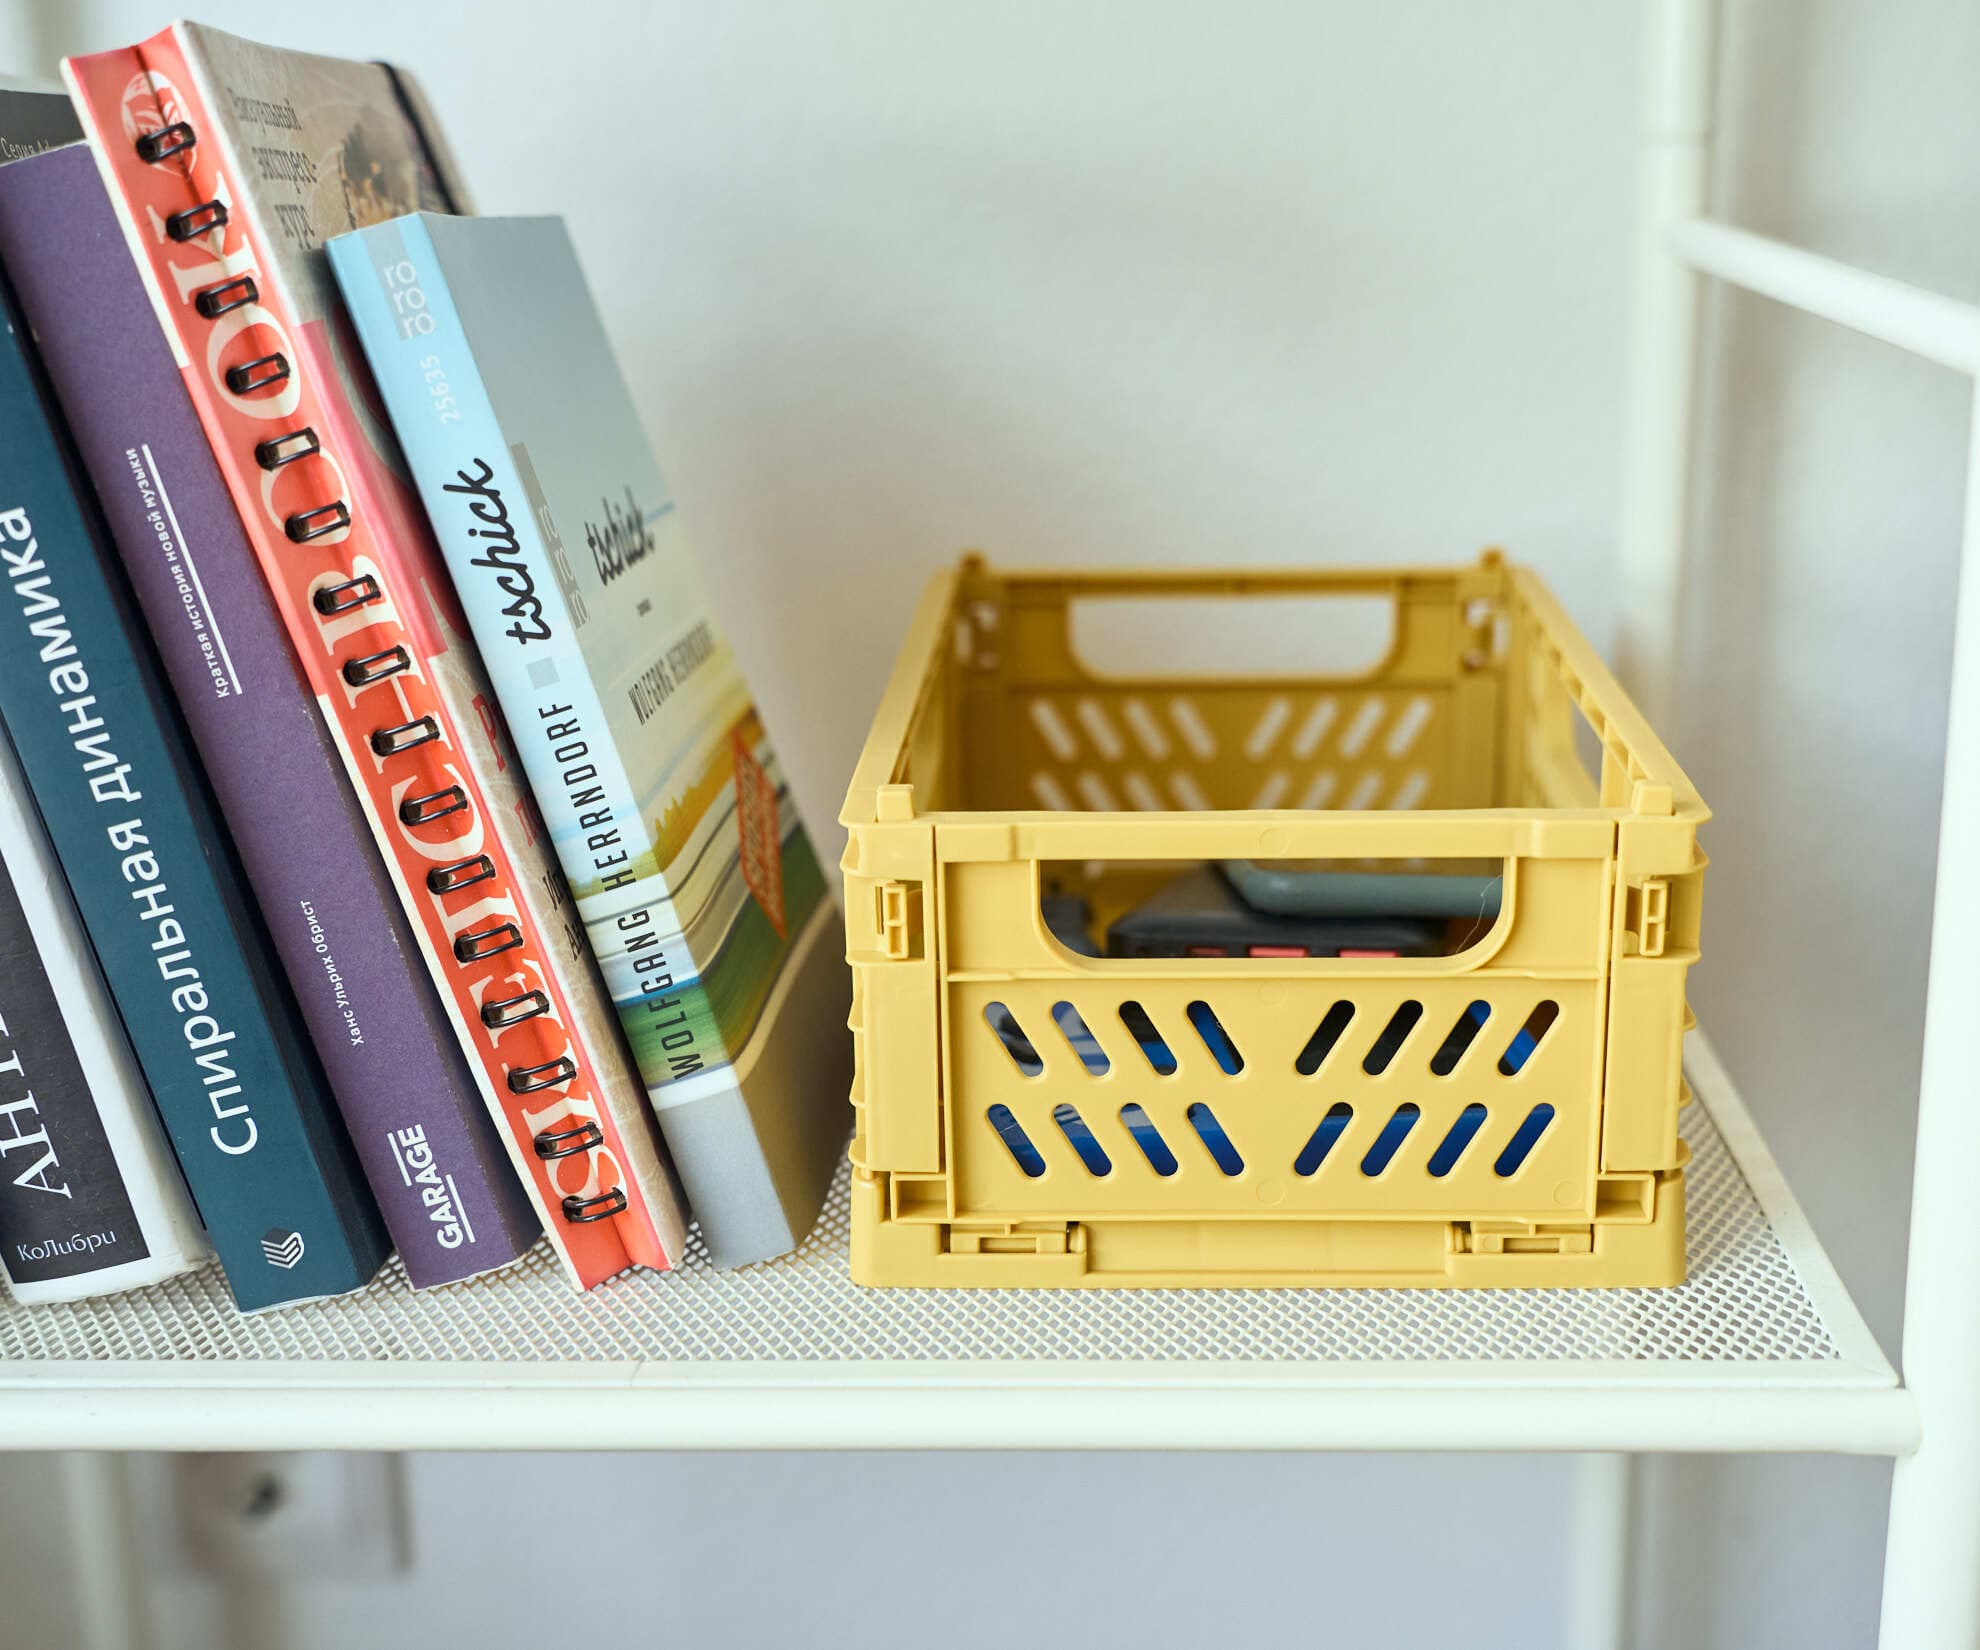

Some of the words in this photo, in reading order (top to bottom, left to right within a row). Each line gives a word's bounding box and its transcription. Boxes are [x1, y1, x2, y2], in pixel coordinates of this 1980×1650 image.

[419, 354, 461, 425] 25635
[126, 448, 156, 509] музыки
[147, 511, 177, 562] новой
[443, 457, 552, 646] tschick
[171, 566, 204, 631] история
[0, 506, 142, 802] динамика
[145, 171, 628, 1202] SKETCHBOOK
[197, 633, 230, 698] Краткая
[538, 703, 637, 893] HERRNDORF
[300, 900, 328, 953] Обрист
[107, 818, 258, 1156] Спиральная
[322, 955, 349, 1008] Ульрих
[618, 909, 704, 1080] WOLFGANG
[344, 1010, 364, 1046] Ханс
[397, 1124, 464, 1249] GARAGE
[16, 1230, 117, 1262] КоЛибри
